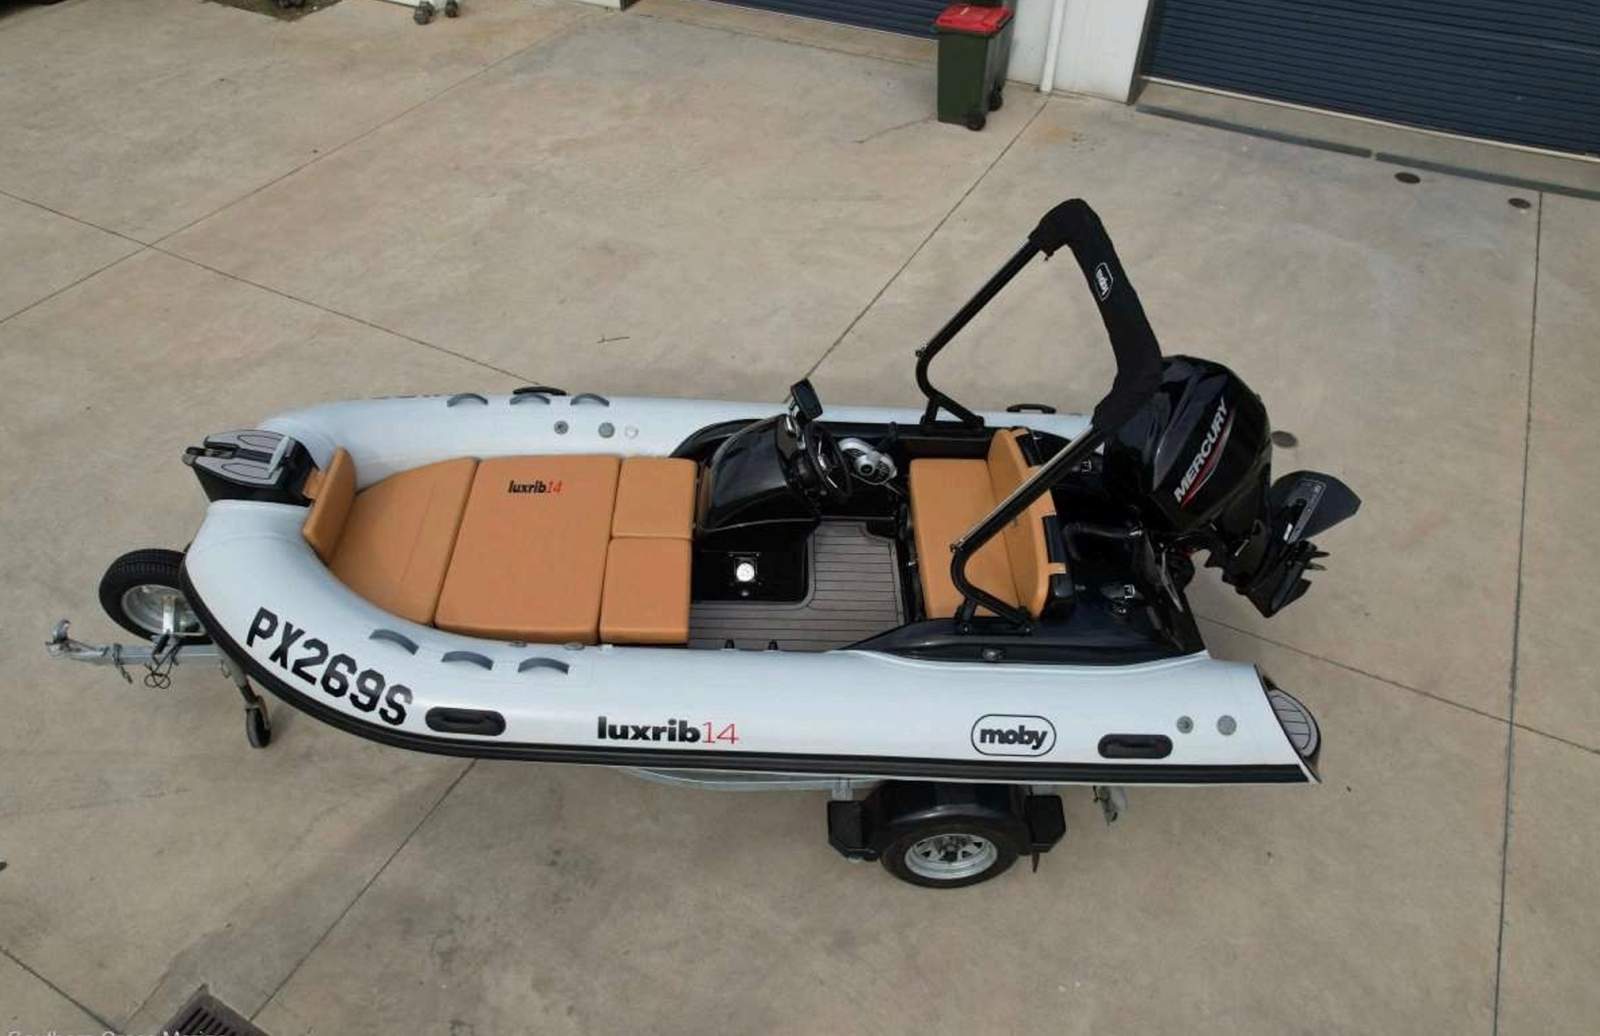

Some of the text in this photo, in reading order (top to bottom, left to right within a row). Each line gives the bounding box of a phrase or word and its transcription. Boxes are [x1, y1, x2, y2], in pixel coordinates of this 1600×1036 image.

[1174, 396, 1227, 502] MERCURY
[508, 480, 562, 493] luxrib14
[246, 607, 413, 726] PX269S
[597, 716, 739, 744] luxrib14
[980, 725, 1048, 750] moby
